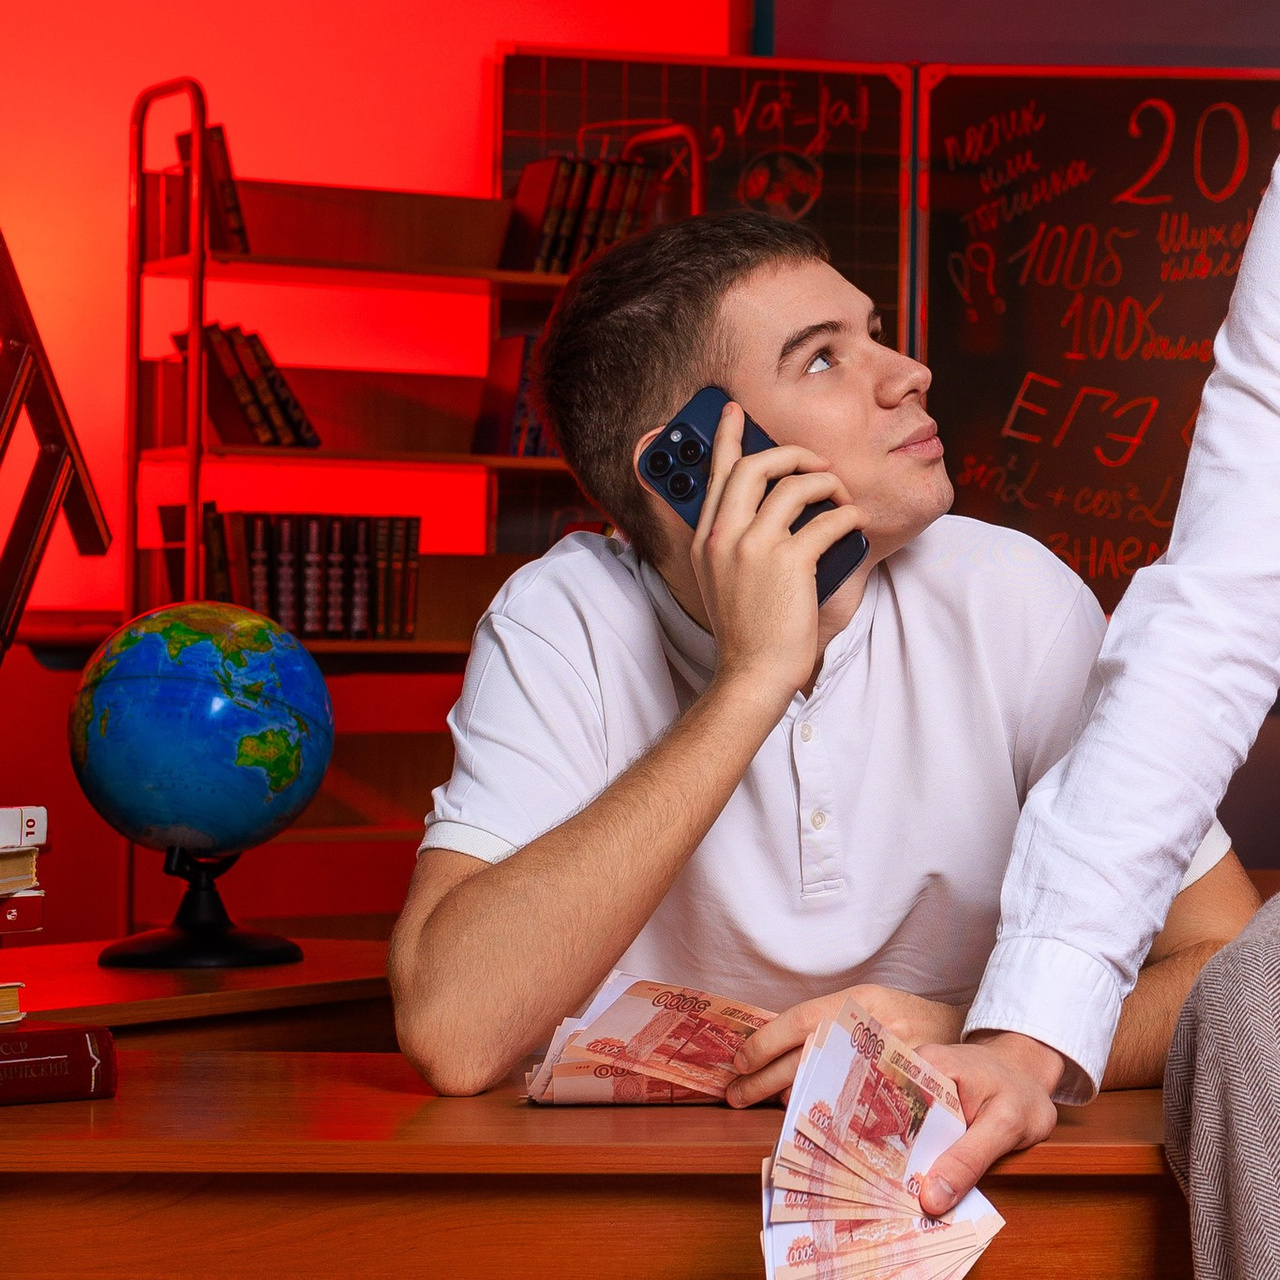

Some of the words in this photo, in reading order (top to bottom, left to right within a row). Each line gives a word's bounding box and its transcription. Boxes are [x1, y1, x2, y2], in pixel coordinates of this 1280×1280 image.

[1000, 370, 1160, 468] ЕГЭ
[651, 990, 711, 1017] 5000
[850, 1021, 886, 1063] 5000
